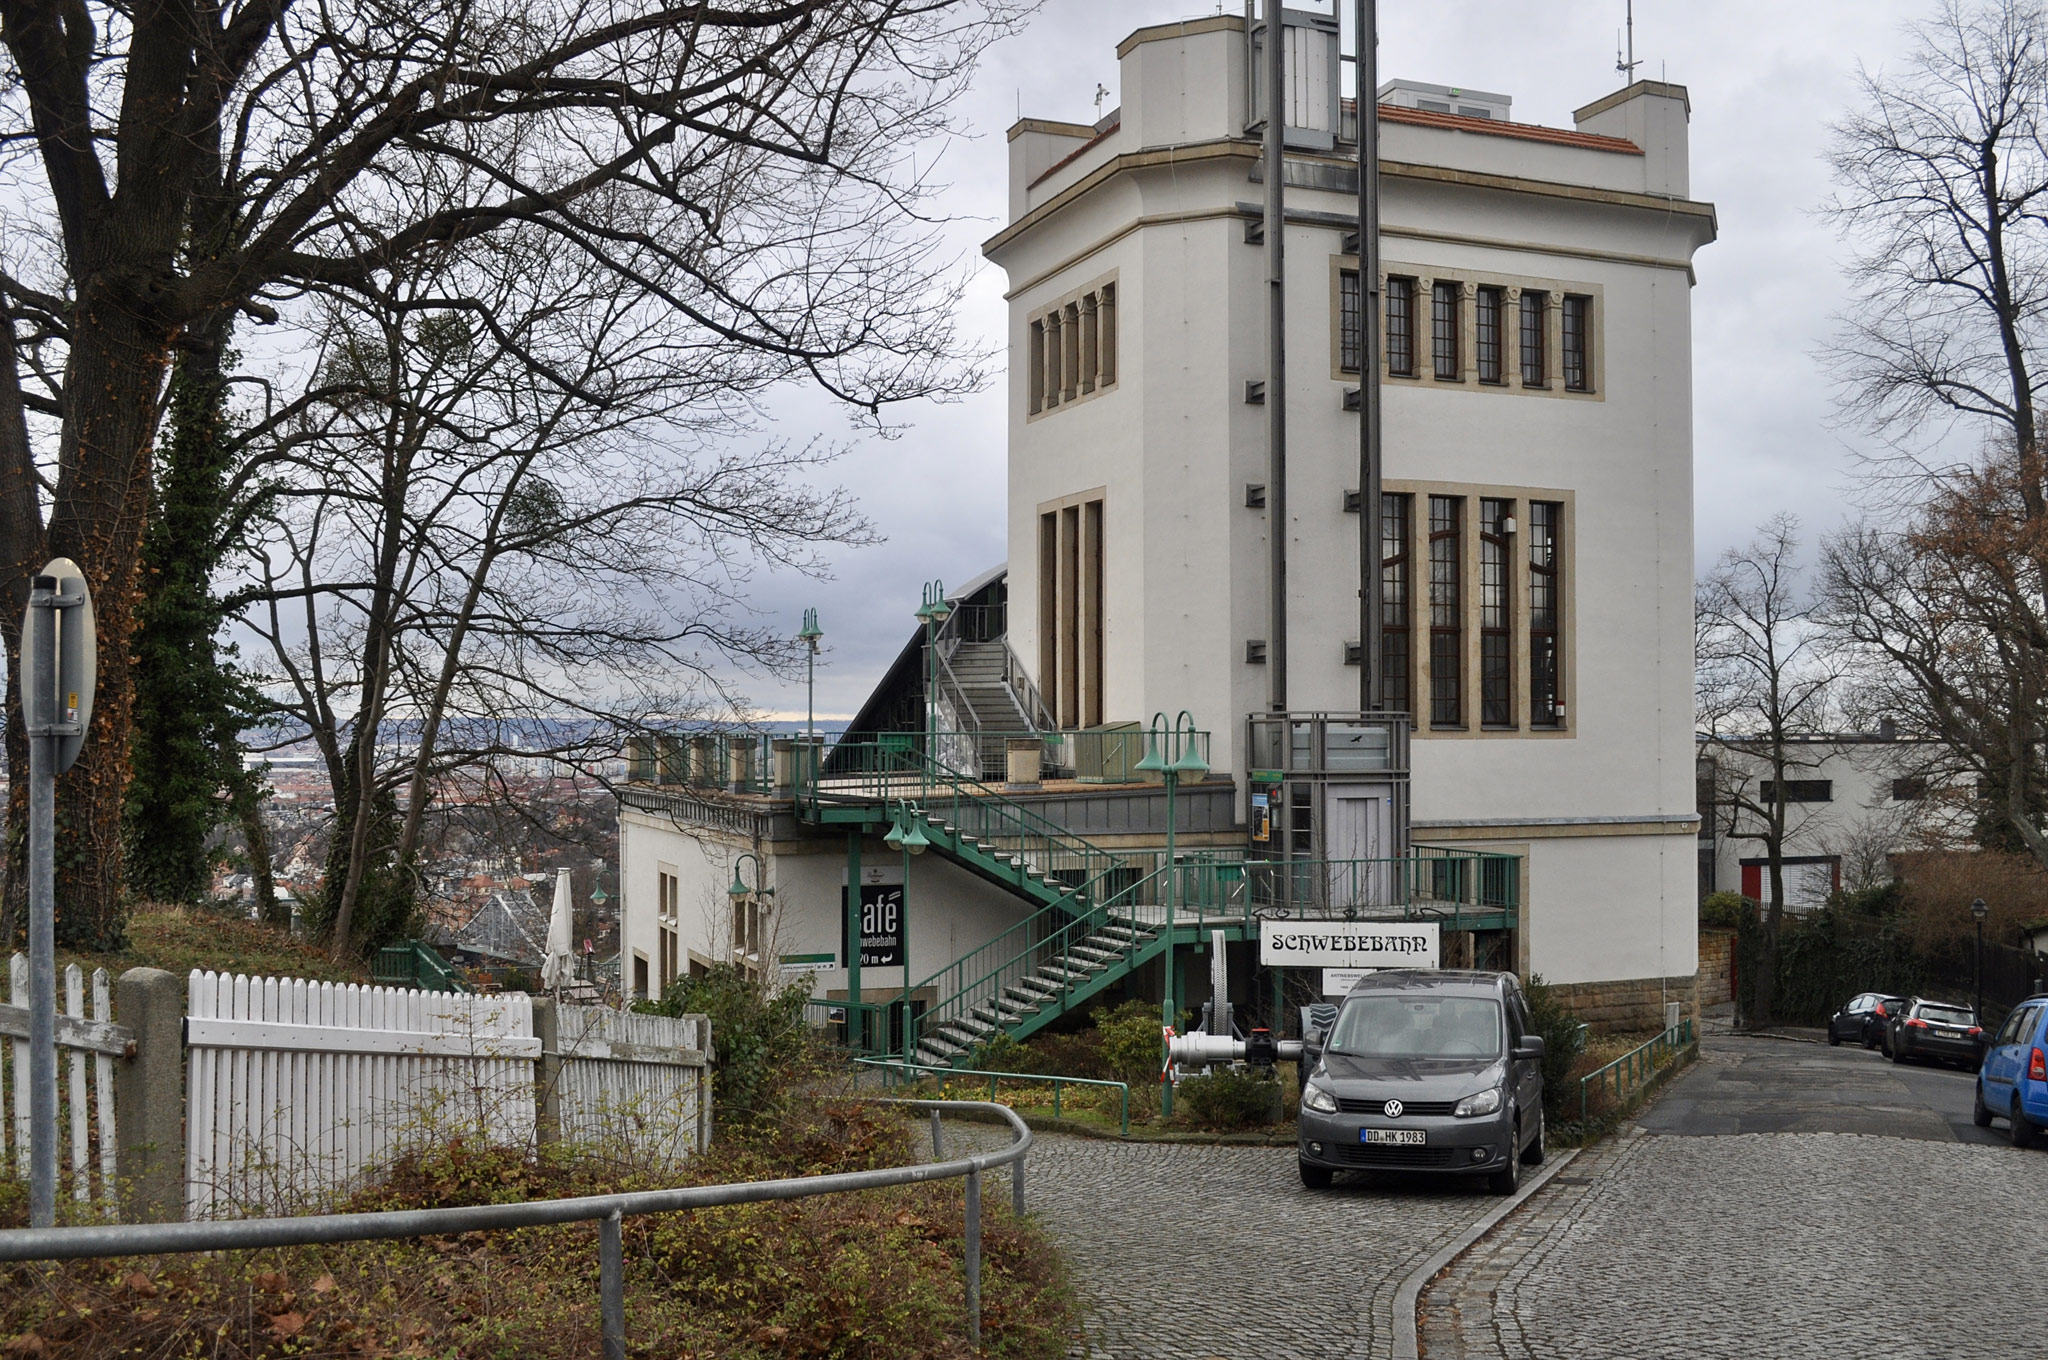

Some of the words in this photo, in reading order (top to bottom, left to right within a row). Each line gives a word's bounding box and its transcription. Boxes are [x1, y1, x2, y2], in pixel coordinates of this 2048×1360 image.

[860, 890, 901, 934] afé
[1272, 934, 1428, 955] SCHWEBEBAHN
[1367, 1130, 1379, 1142] DD
[1385, 1131, 1398, 1142] HK
[1399, 1132, 1425, 1143] 1983
